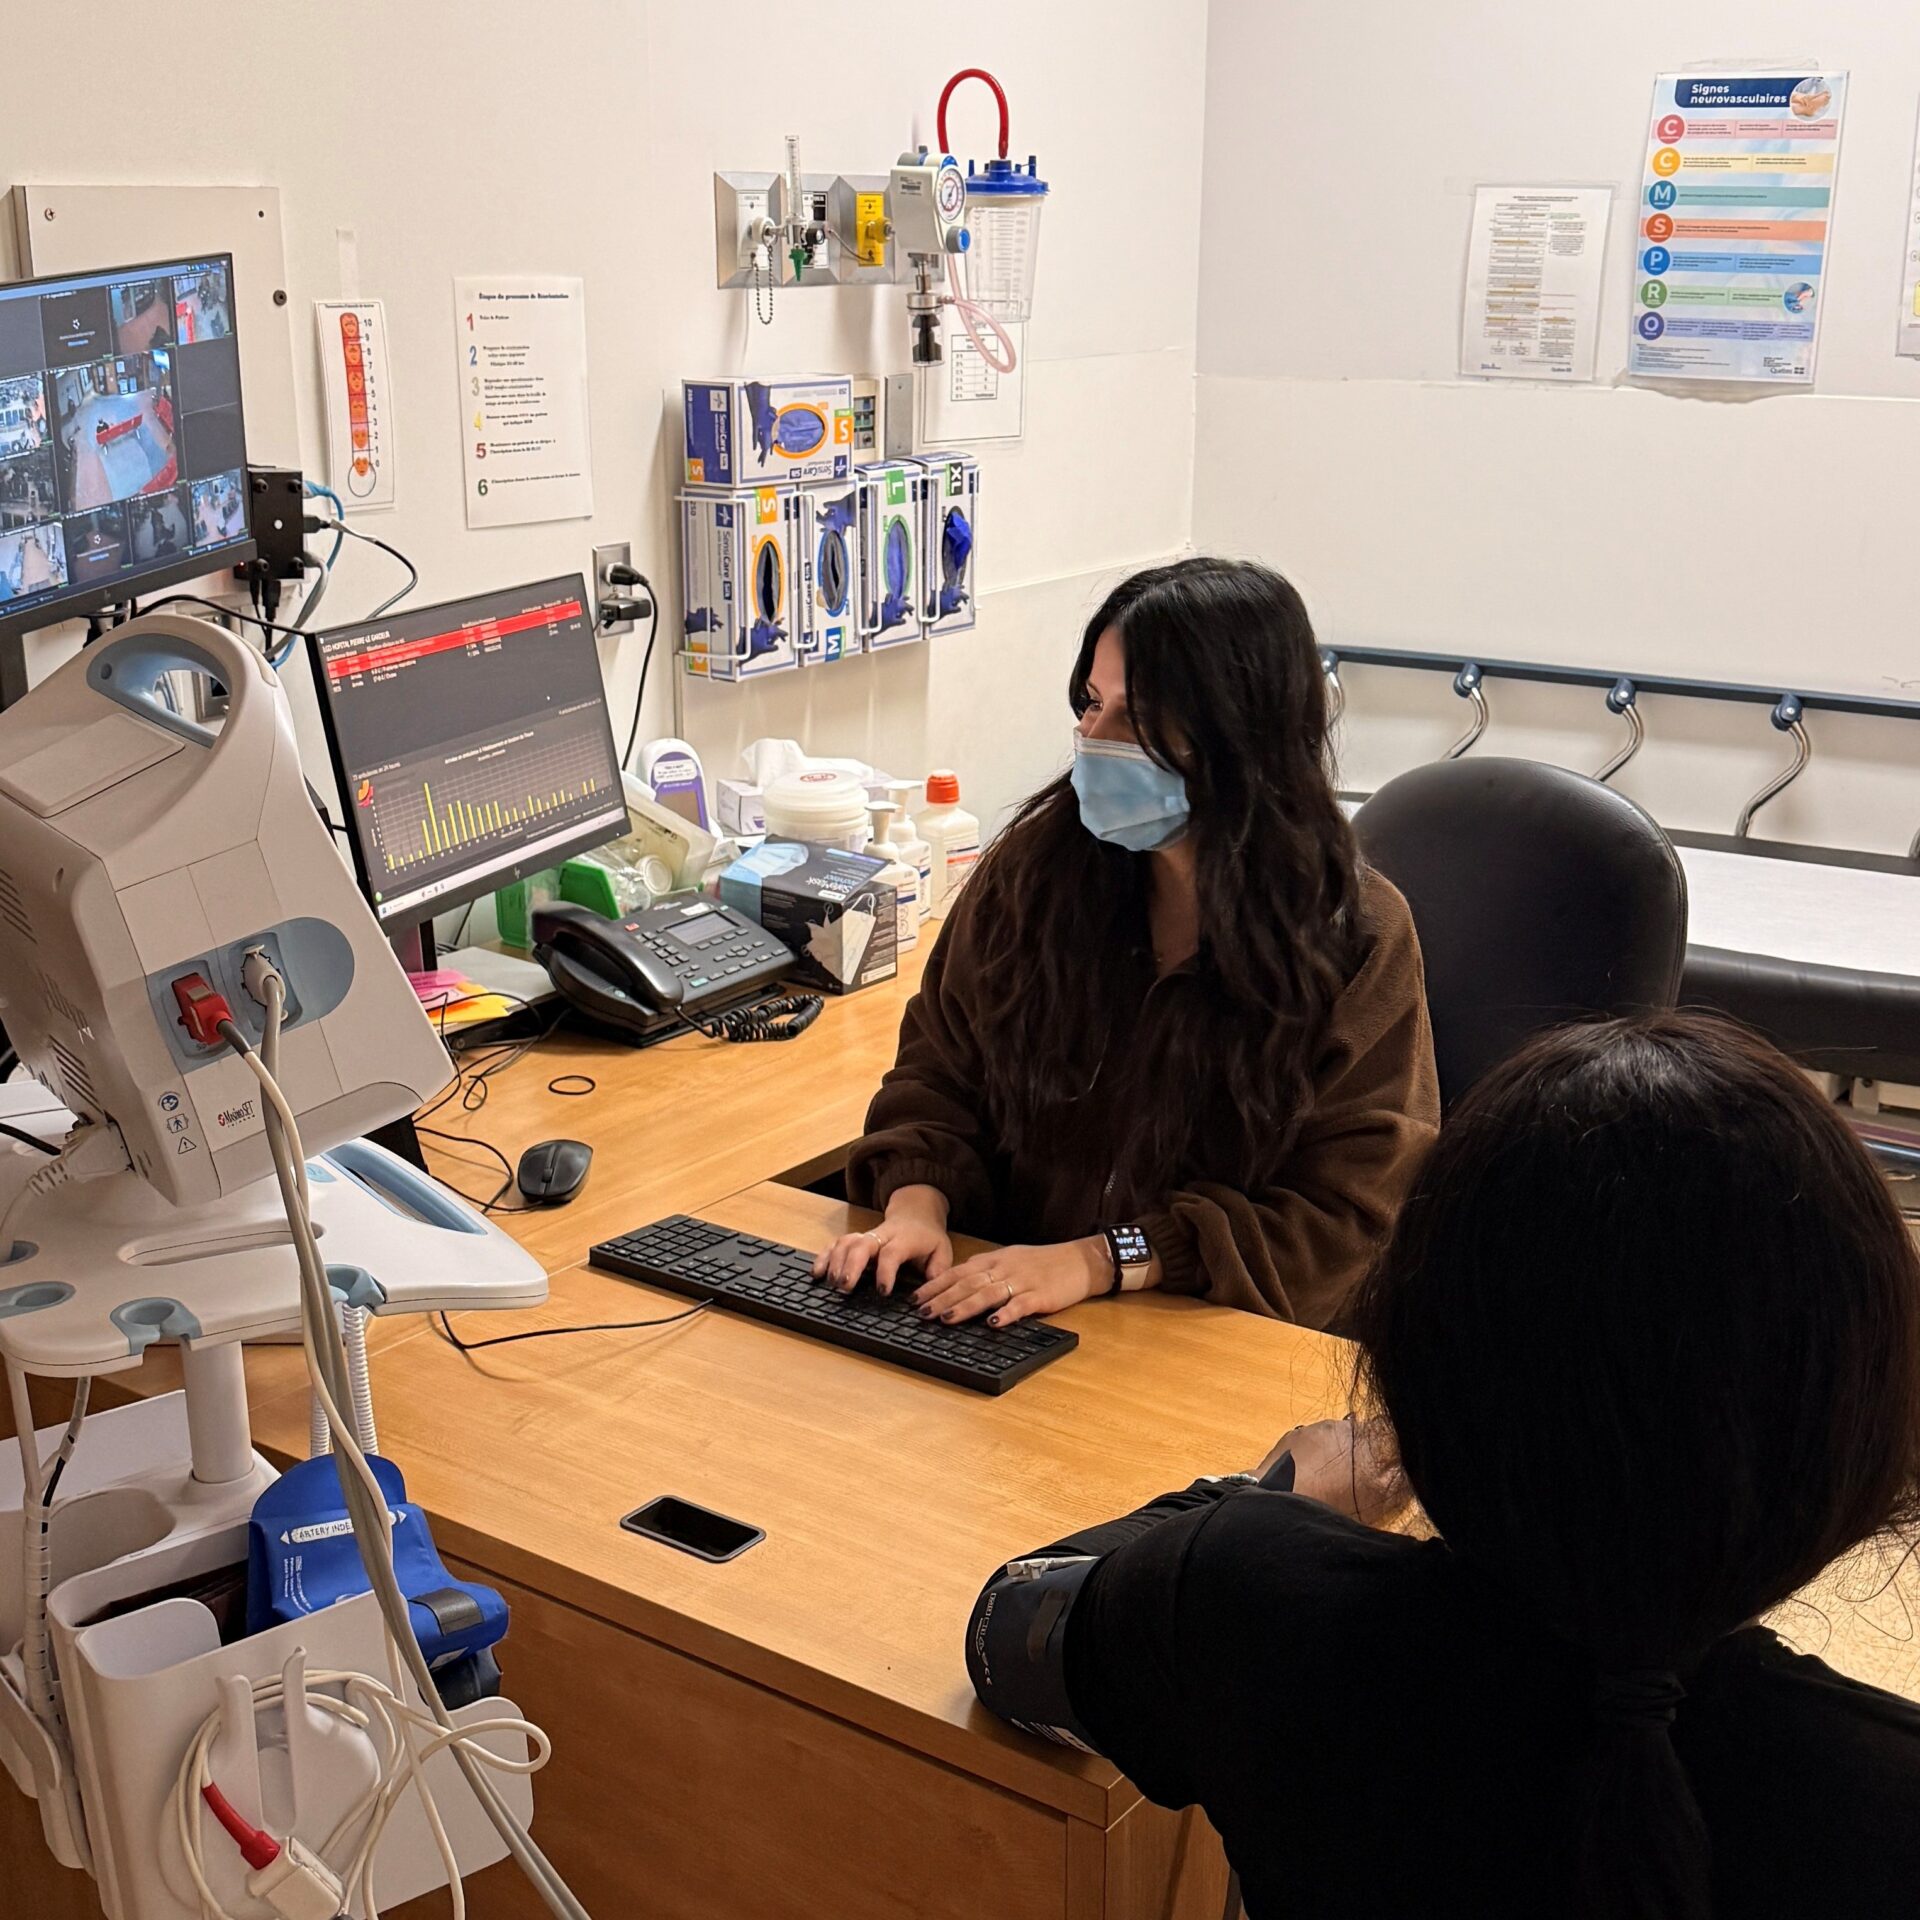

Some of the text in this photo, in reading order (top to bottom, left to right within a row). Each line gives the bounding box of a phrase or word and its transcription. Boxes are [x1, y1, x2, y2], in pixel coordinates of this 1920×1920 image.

[1692, 84, 1730, 94] Signes
[1690, 94, 1787, 104] neurovasculaires
[1664, 119, 1678, 134] C
[1660, 153, 1673, 168] C
[1654, 186, 1670, 200] M
[1653, 218, 1666, 233] S
[1650, 250, 1663, 266] P
[1648, 284, 1660, 298] R
[466, 313, 474, 331] 1
[1644, 316, 1659, 330] O
[470, 345, 477, 366] 2
[472, 377, 479, 396] 3
[474, 410, 482, 431] 4
[719, 414, 727, 453] SensiCare
[840, 420, 848, 440] S
[476, 442, 486, 459] 5
[692, 465, 703, 476] S
[804, 465, 832, 476] SensiCare
[478, 479, 488, 496] 6
[892, 482, 903, 494] L
[950, 466, 962, 494] XL
[763, 498, 776, 514] S
[723, 531, 731, 577] SensiCare
[828, 634, 840, 654] M
[299, 1522, 351, 1538] ARTERY INDE
